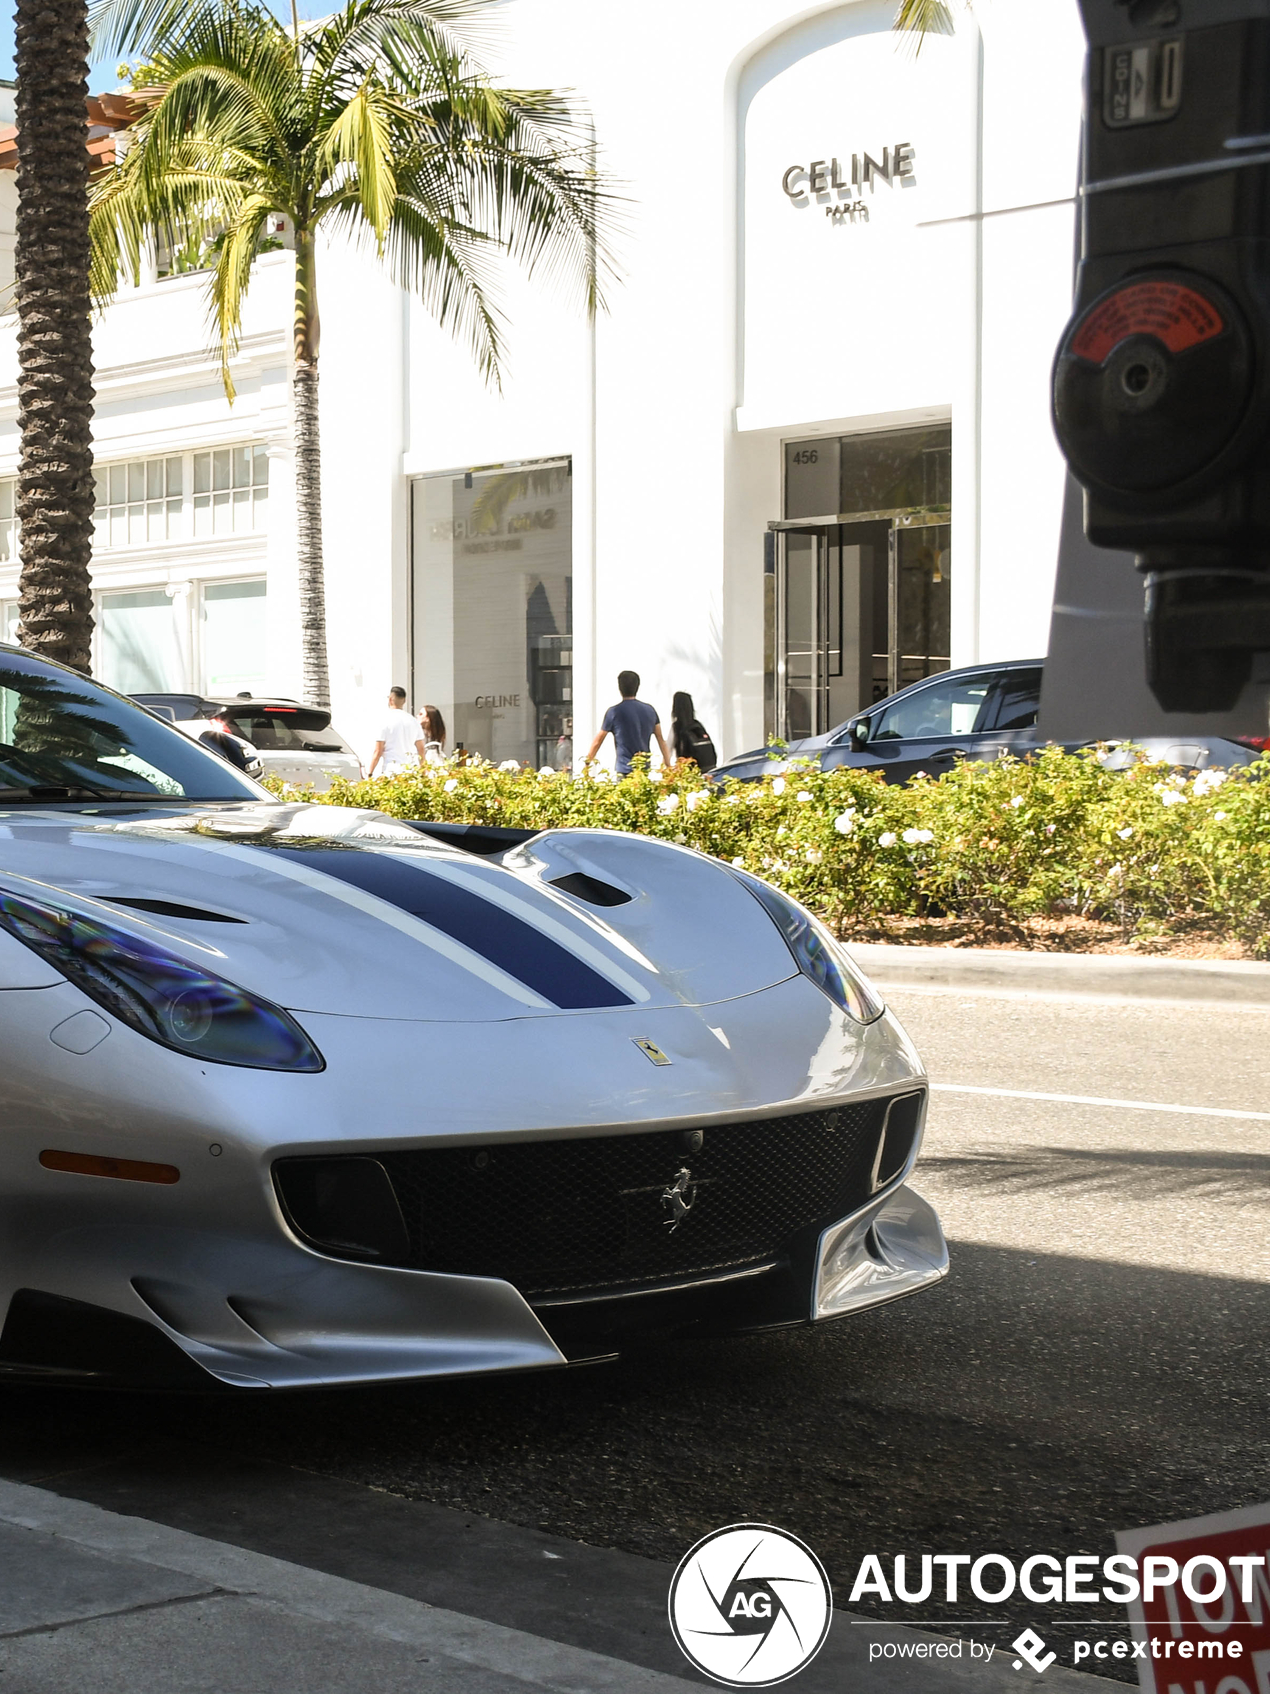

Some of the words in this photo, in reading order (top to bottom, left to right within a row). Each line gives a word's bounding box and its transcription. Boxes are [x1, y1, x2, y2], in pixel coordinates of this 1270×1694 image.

[1114, 55, 1128, 119] COINS
[782, 142, 912, 199] CELINE
[793, 450, 818, 465] 456
[474, 693, 521, 709] CELINE
